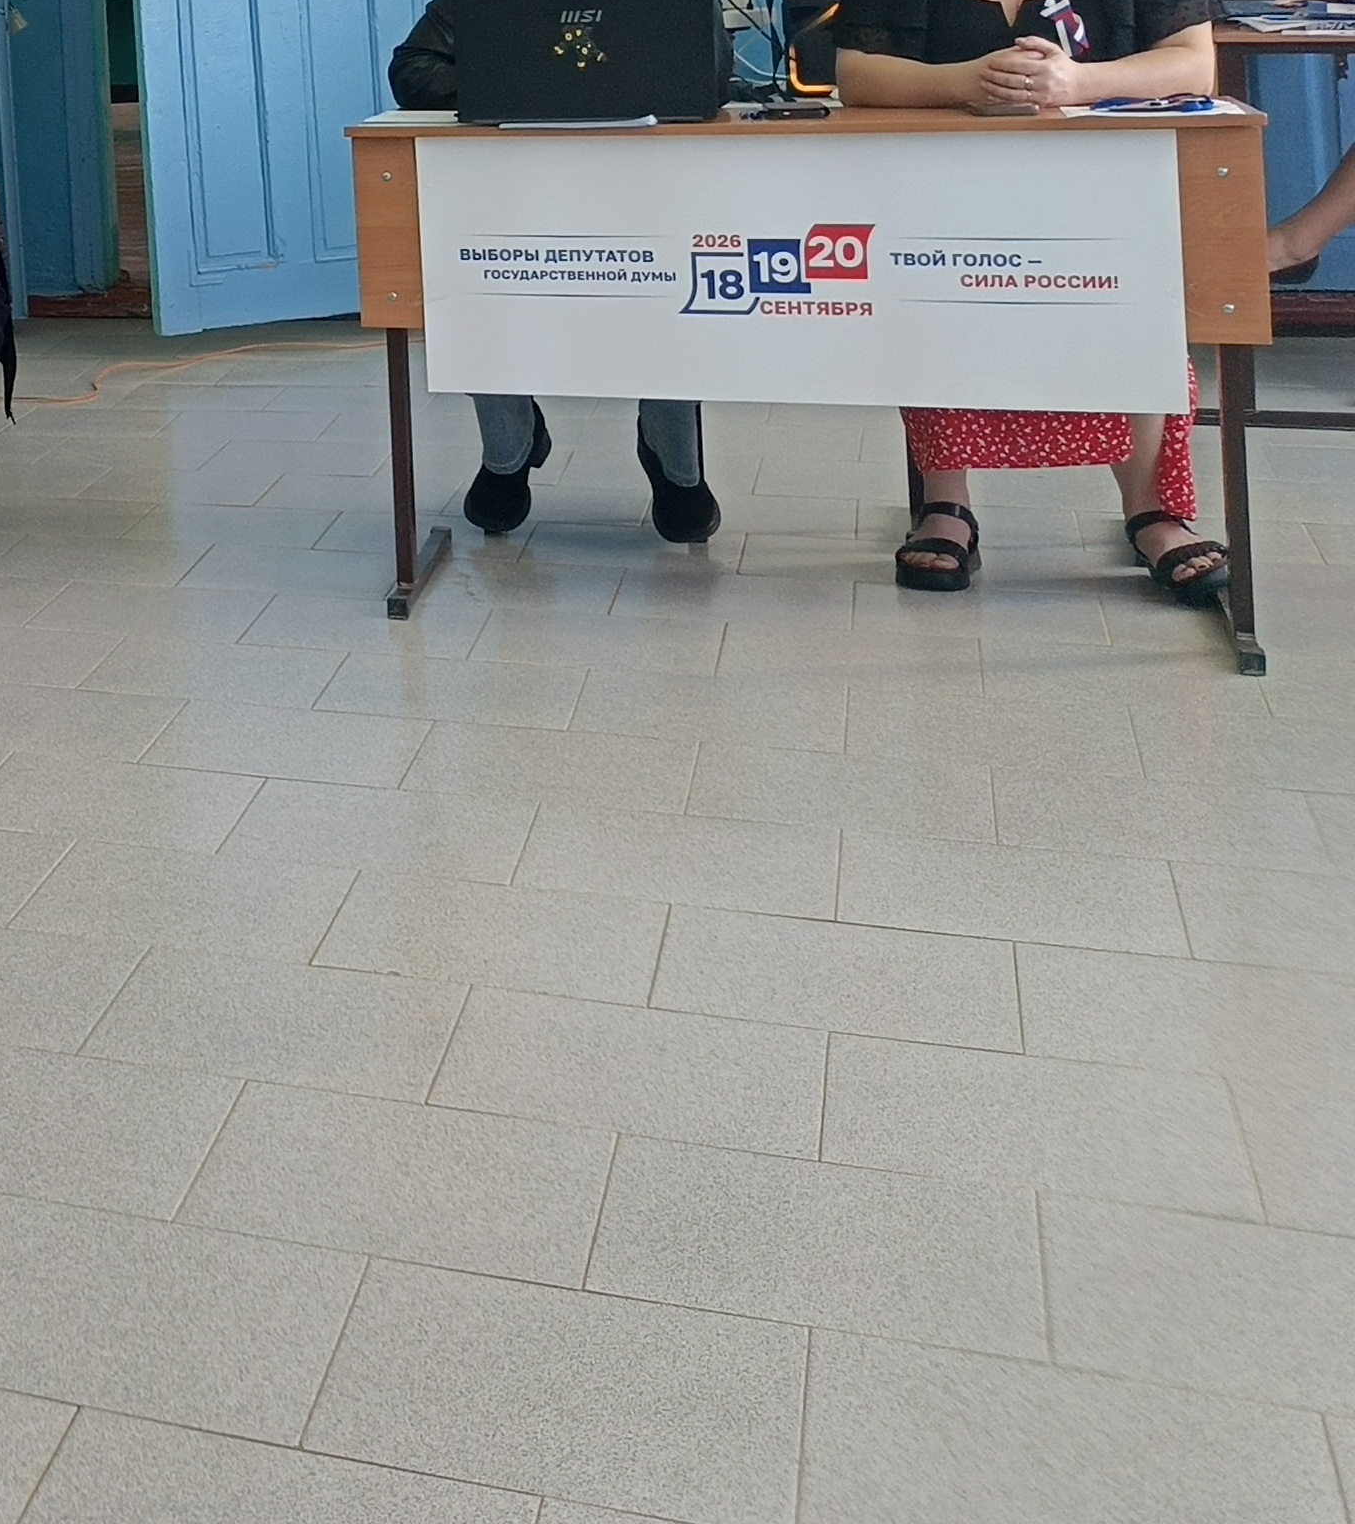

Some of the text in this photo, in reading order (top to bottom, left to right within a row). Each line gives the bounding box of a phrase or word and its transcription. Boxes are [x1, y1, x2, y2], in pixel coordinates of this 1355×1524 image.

[560, 10, 603, 23] MSI
[692, 234, 741, 248] 2026
[459, 248, 655, 264] ВЫБОРЫ ДЕПУТАТОВ
[889, 249, 946, 267] ТВОЙ
[952, 253, 1022, 267] ГОЛОС
[701, 236, 864, 299] 18 19 20
[483, 268, 677, 283] ГОСУДАРСТВЕННОЙ ДУМЫ
[960, 274, 1119, 289] СИЛА РОССИИ!
[760, 300, 873, 316] СЕНТЯБРЯ
